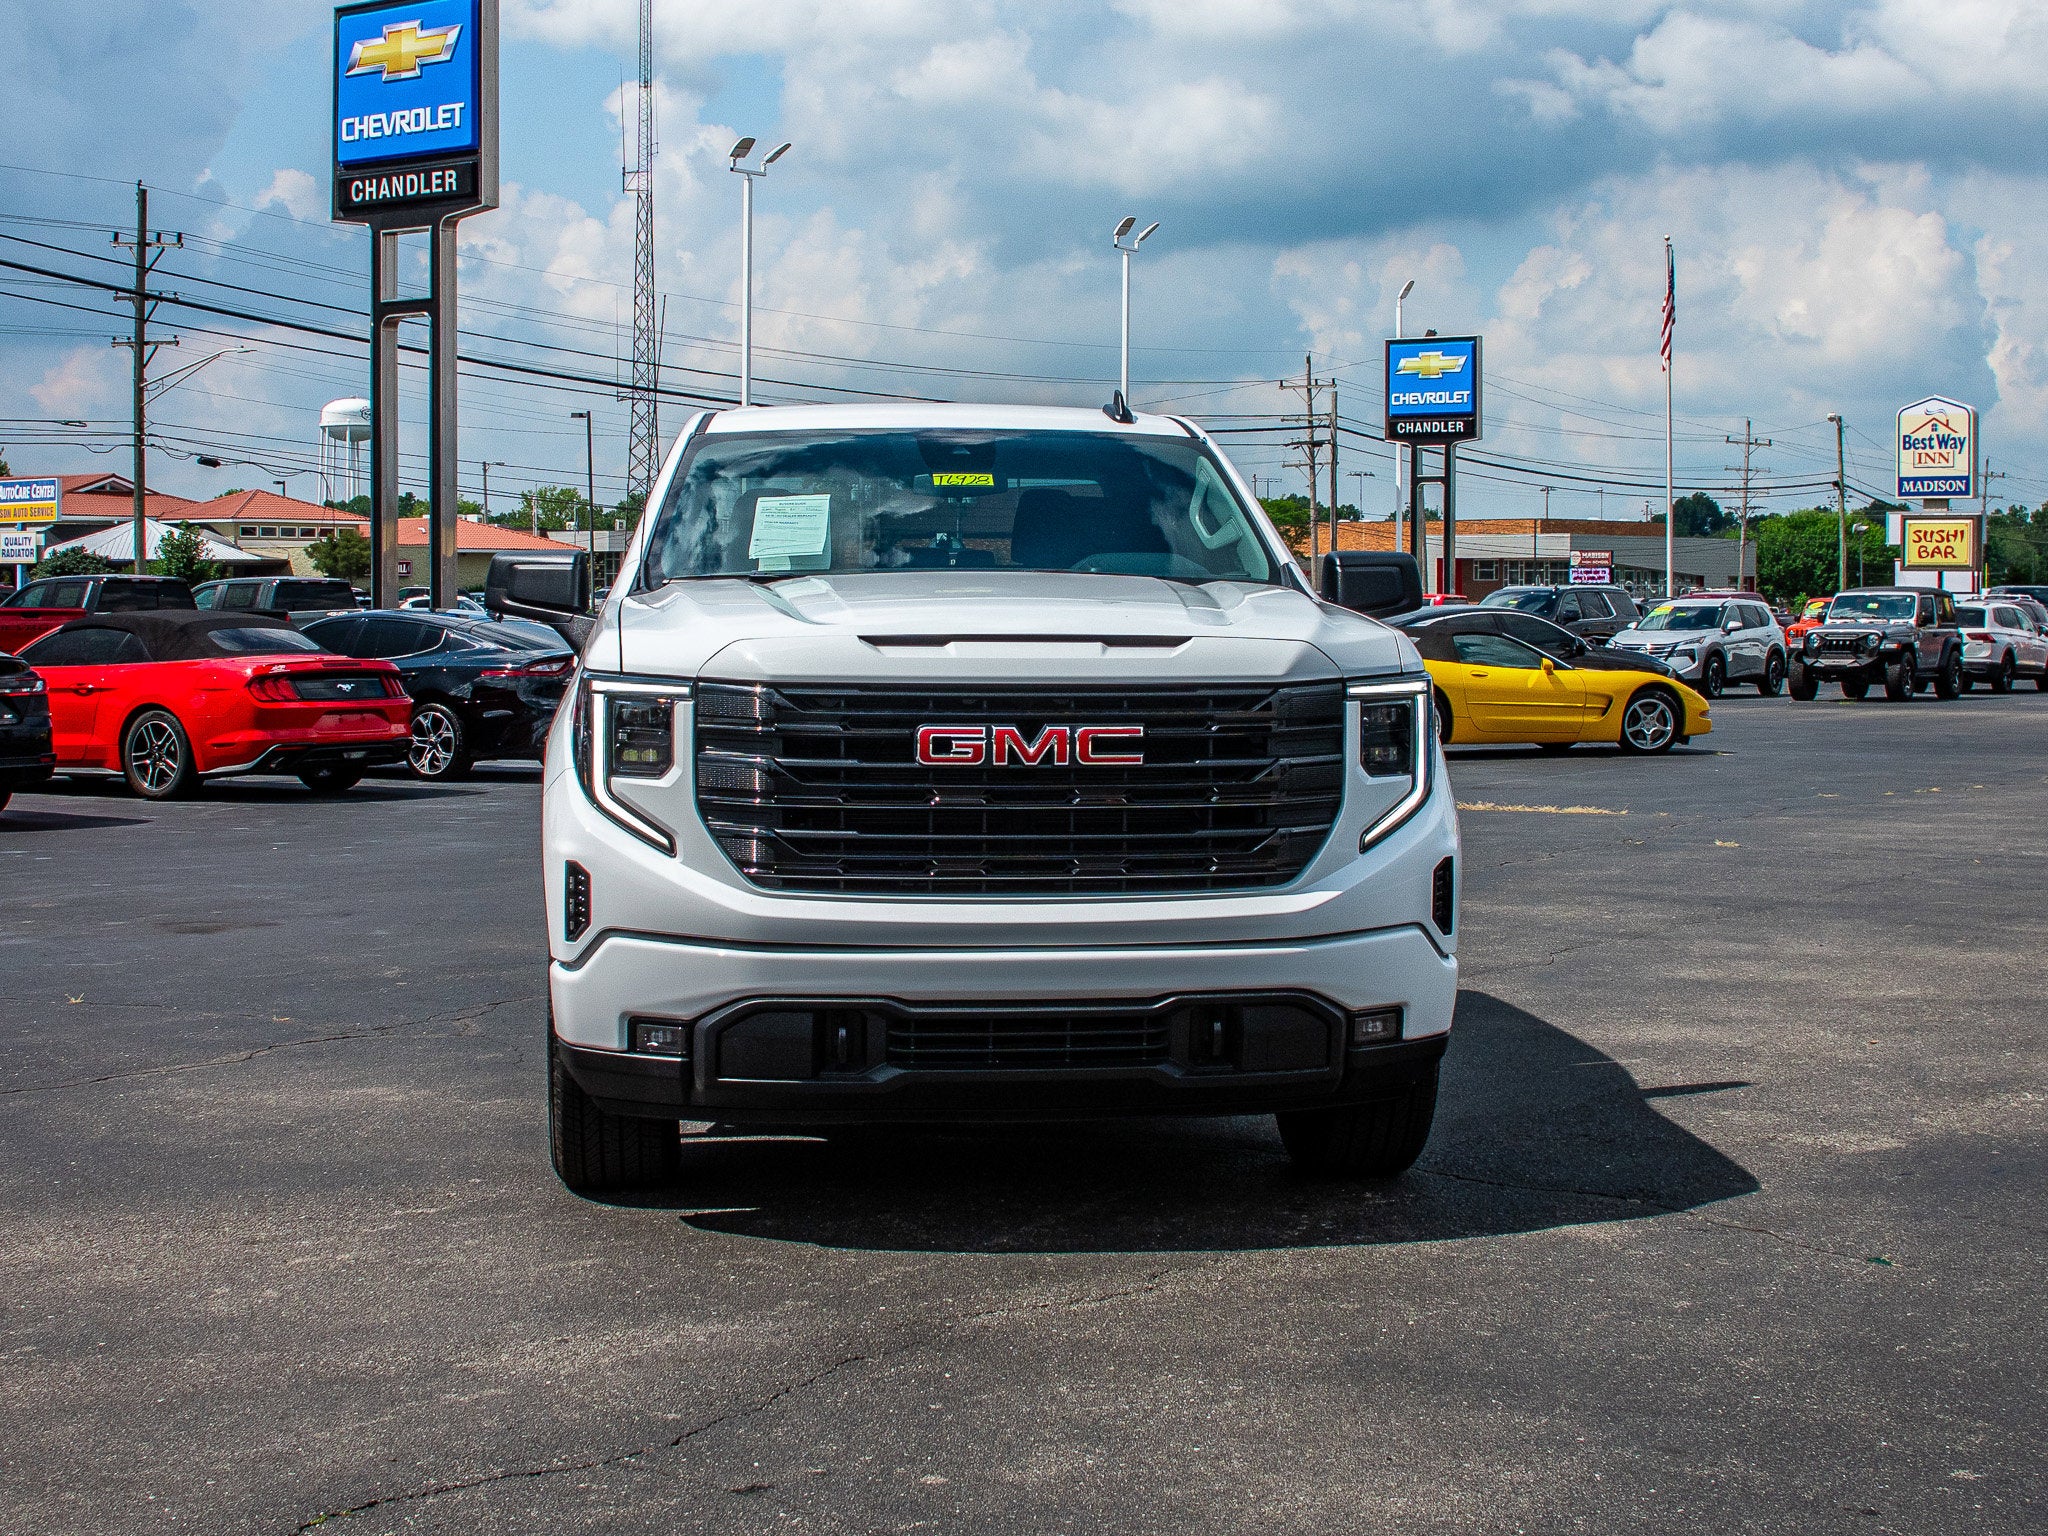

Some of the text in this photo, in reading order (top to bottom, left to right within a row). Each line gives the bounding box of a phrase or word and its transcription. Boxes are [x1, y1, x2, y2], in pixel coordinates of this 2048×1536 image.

[341, 102, 465, 142] CHEVROLET
[351, 169, 457, 203] CHANDLER
[1391, 390, 1471, 406] CHEVROLET
[1397, 421, 1464, 433] CHANDLER
[1902, 433, 1967, 455] Best Way
[1917, 452, 1951, 465] INN
[1902, 480, 1967, 493] MADISON
[13, 507, 29, 518] AUTO
[4, 536, 33, 547] QUALITY
[1912, 529, 1965, 544] SUSHI
[1, 548, 35, 558] RADIATOR
[1917, 545, 1957, 559] BAR
[915, 724, 1145, 766] GMC
